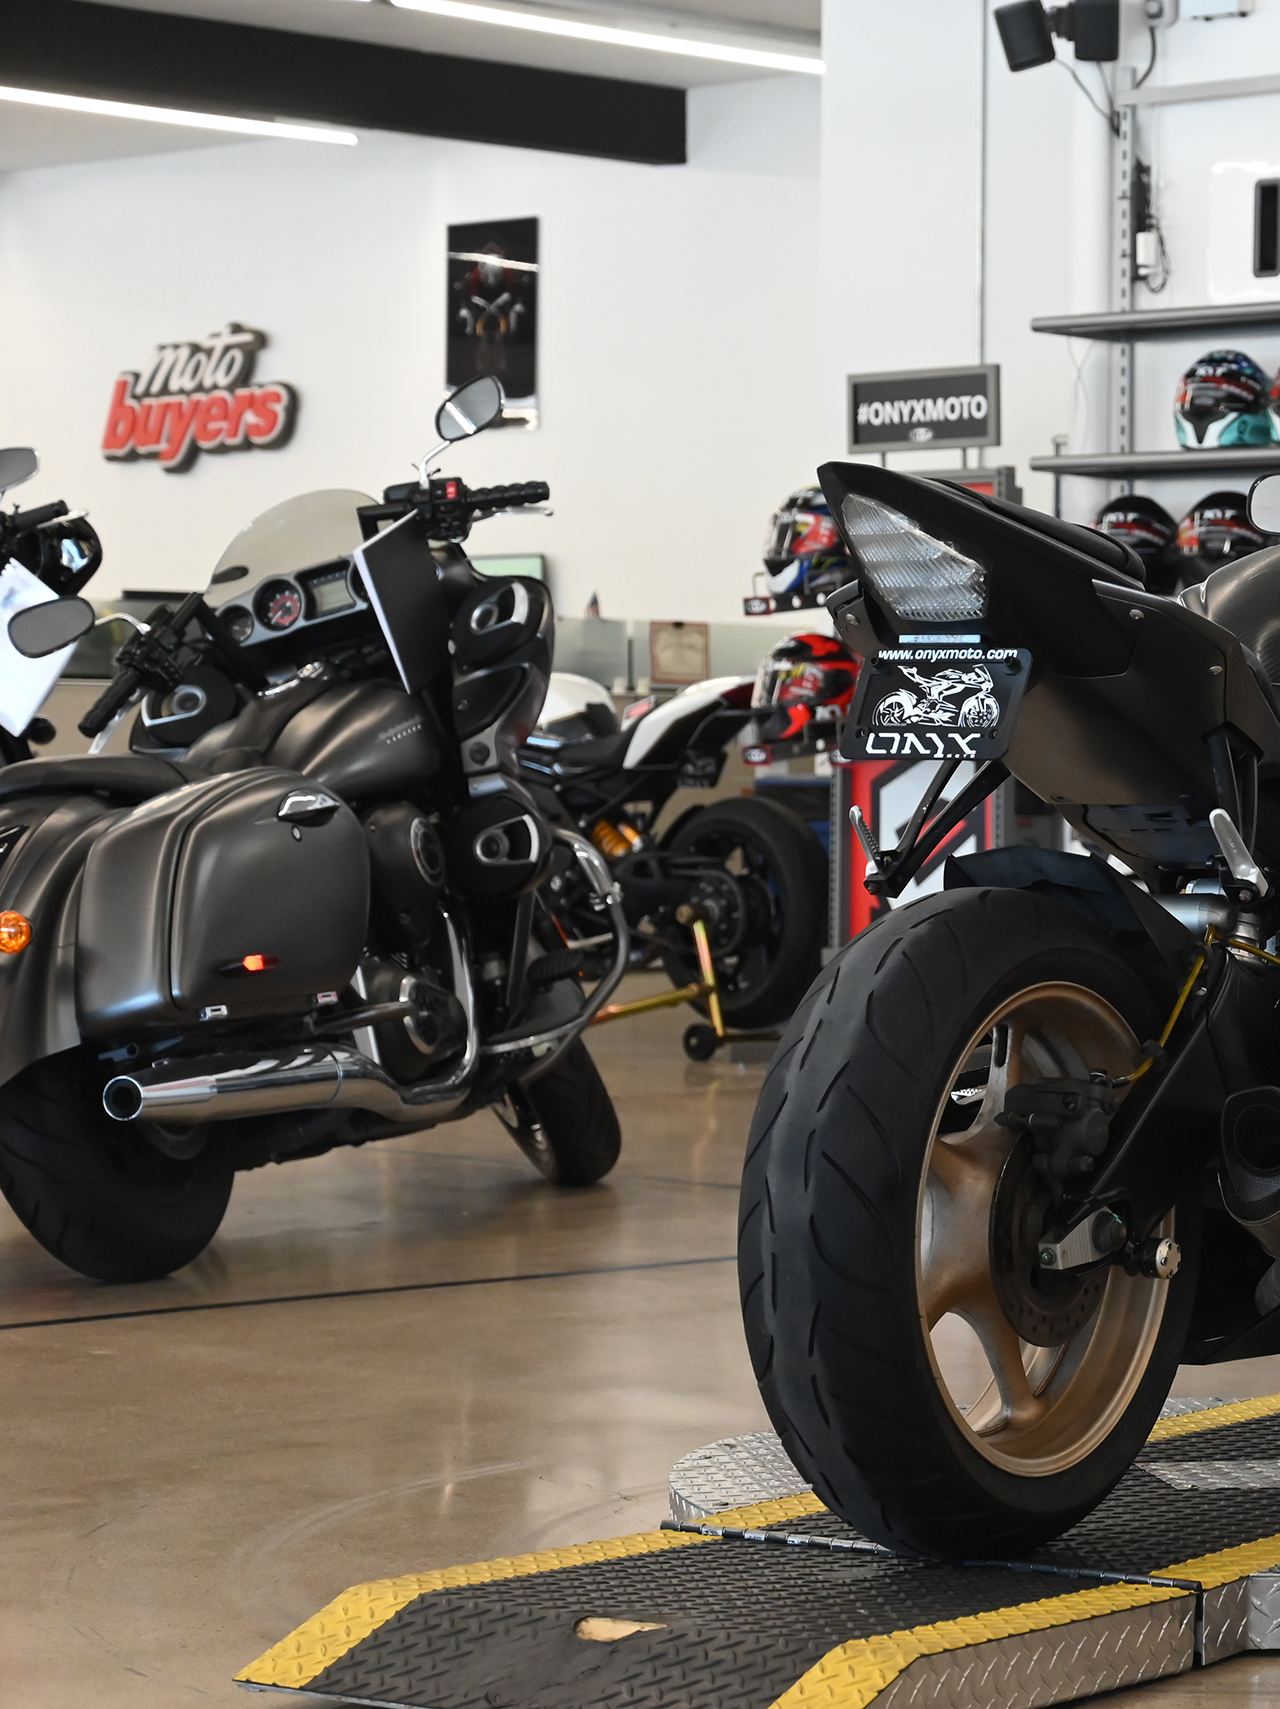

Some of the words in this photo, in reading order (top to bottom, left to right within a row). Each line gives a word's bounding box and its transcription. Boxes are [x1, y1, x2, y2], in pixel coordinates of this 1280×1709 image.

[101, 376, 285, 463] buyers
[857, 394, 988, 427] #ONYXMOTO
[878, 648, 1019, 663] www.onyxmoto.com
